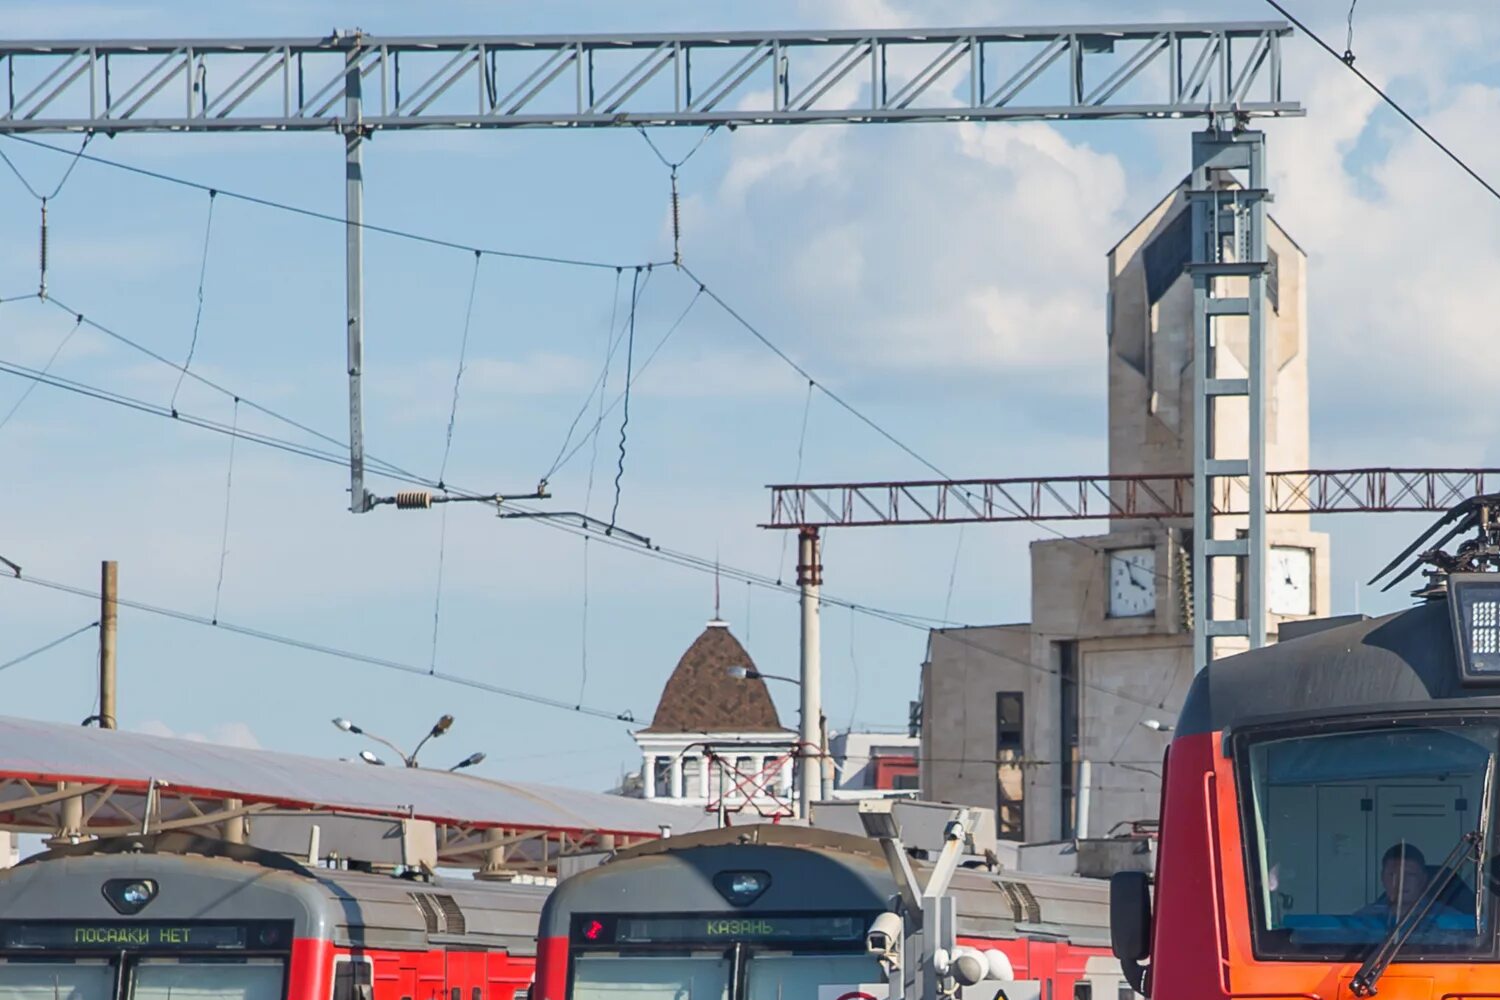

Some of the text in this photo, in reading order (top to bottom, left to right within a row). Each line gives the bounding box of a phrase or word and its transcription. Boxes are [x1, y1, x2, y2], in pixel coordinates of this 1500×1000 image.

[74, 928, 191, 943] ПОСАДКИ НЕТ
[707, 920, 774, 936] КАЗАНЬ
